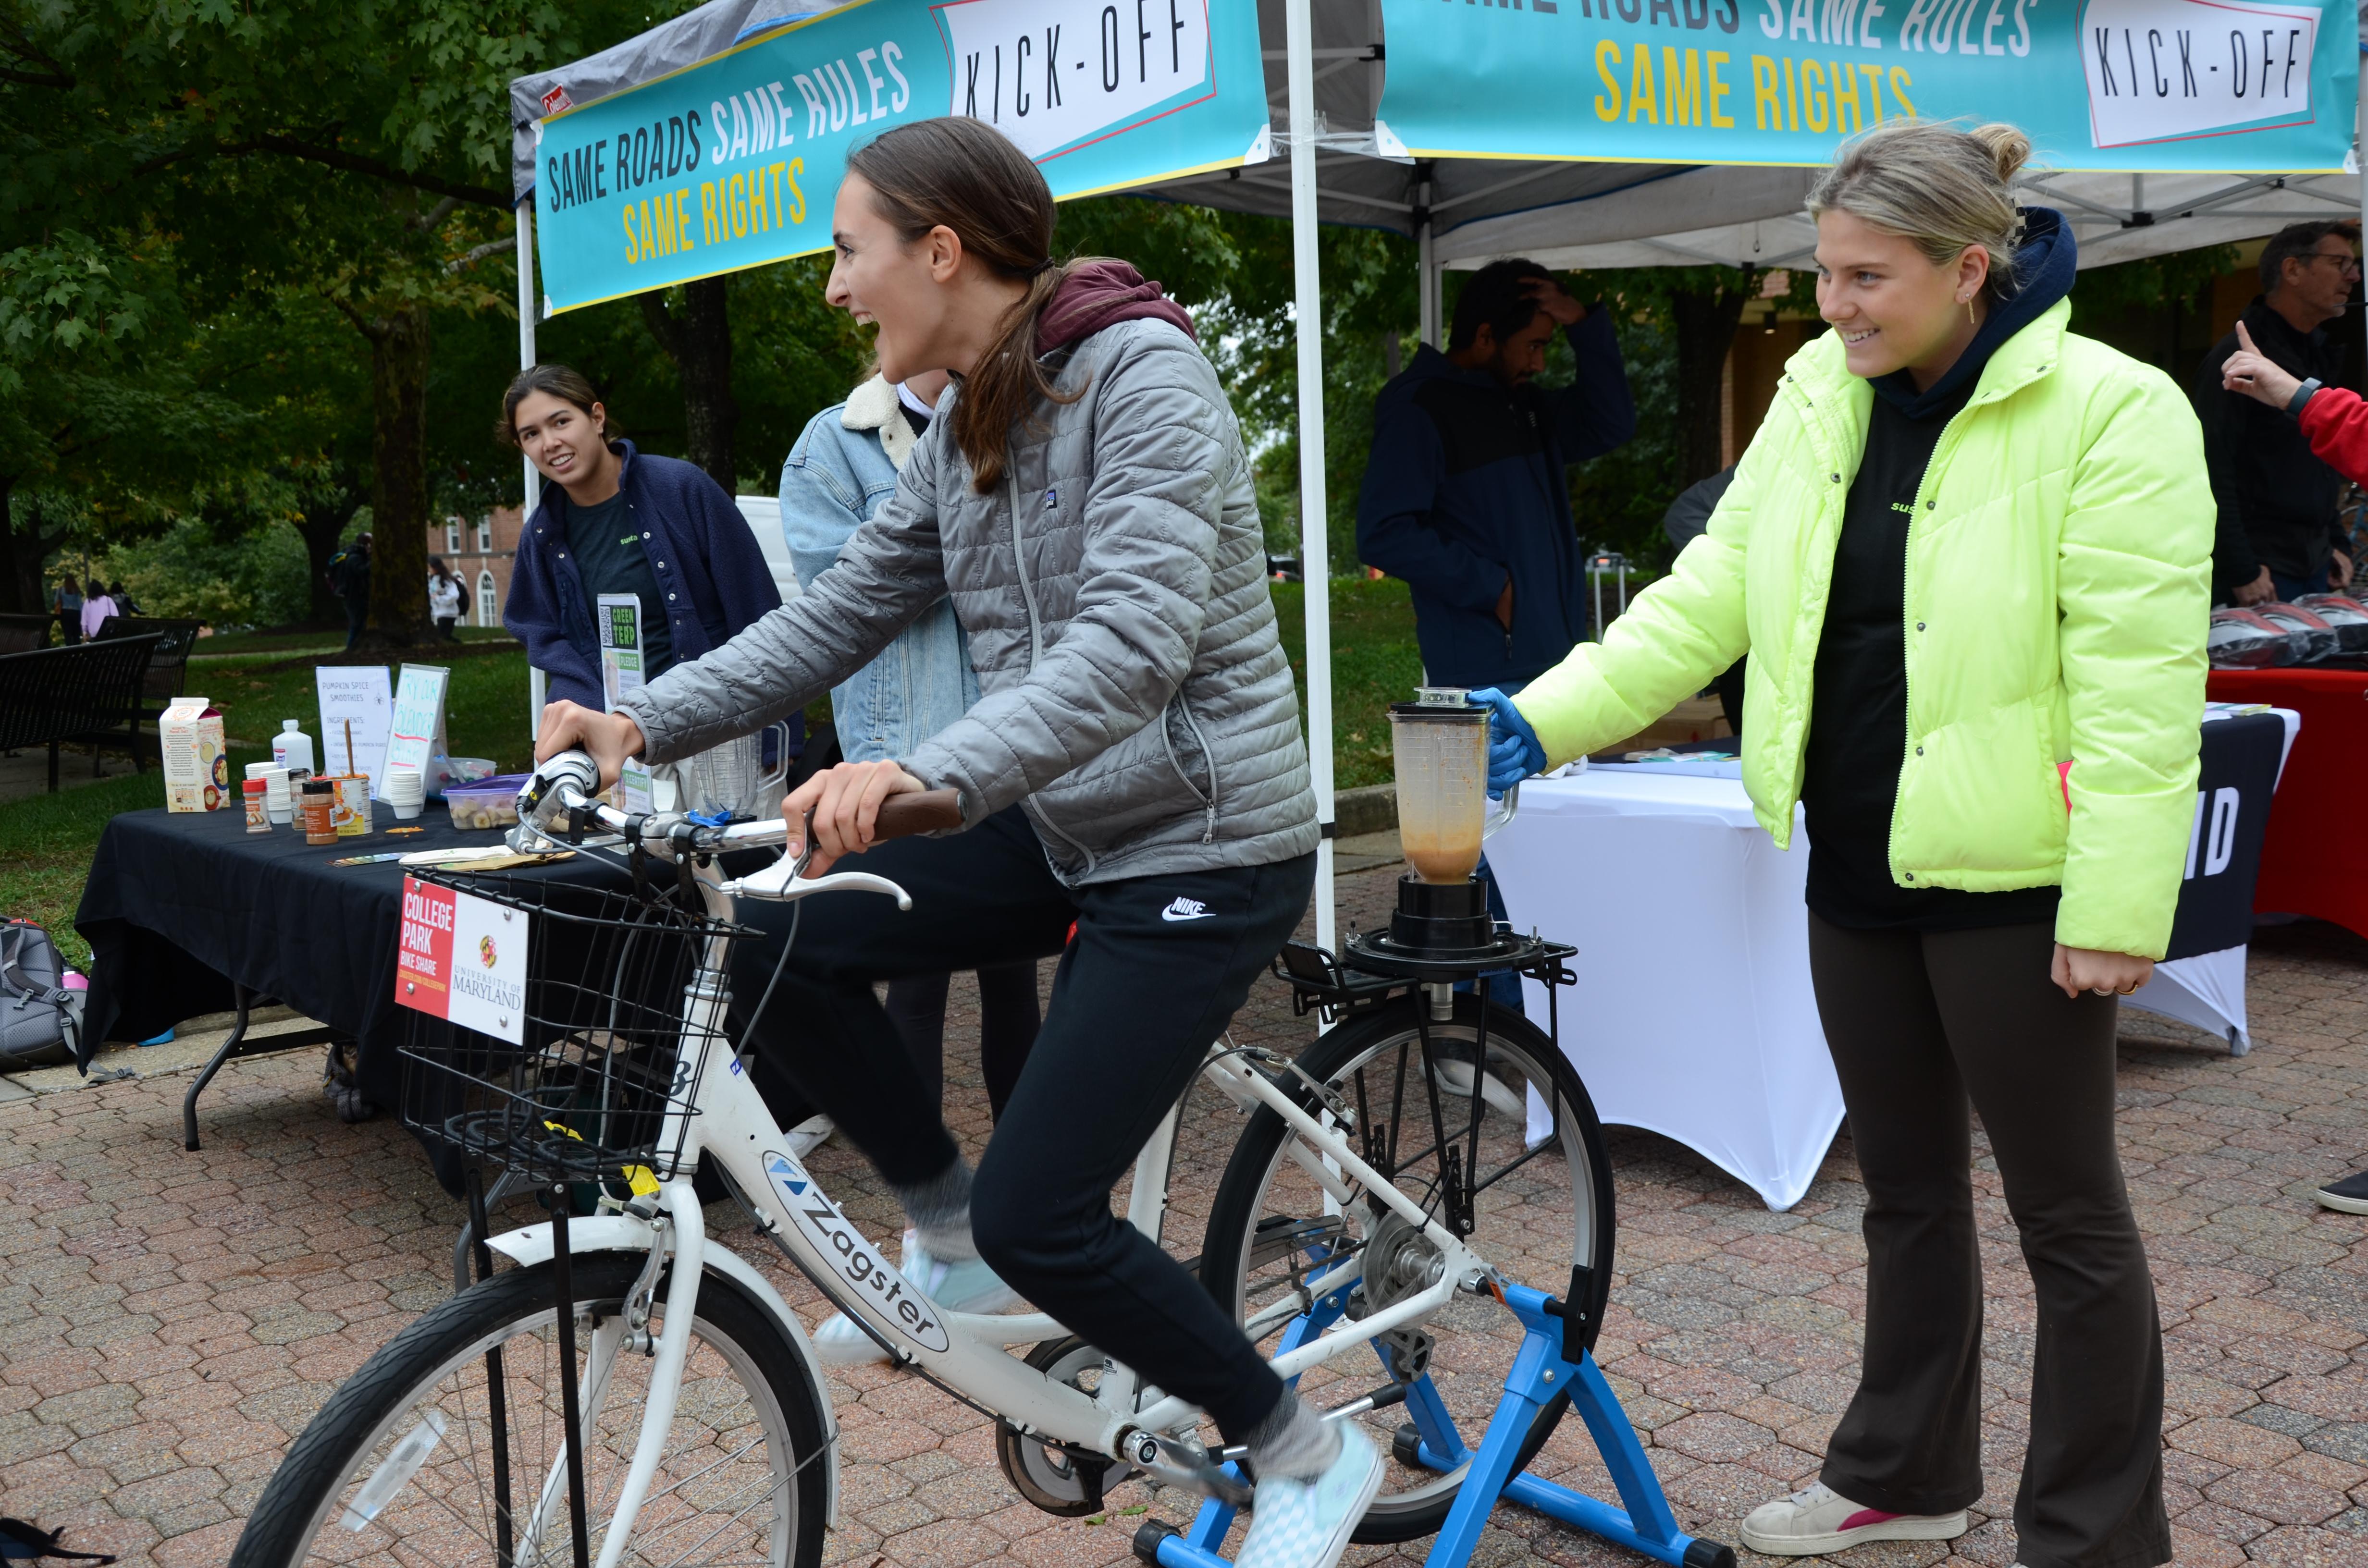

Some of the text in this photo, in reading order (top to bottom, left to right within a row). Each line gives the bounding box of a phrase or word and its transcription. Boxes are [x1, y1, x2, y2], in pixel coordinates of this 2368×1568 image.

[965, 0, 1184, 124] KICK-OFF
[2096, 27, 2300, 98] KICK-OFF
[1594, 39, 1917, 134] SAME RIGHTS
[548, 40, 910, 213] SAME ROADS SAME RULES
[623, 157, 806, 264] SAME RIGHTS
[612, 608, 634, 624] GREEN
[613, 625, 635, 645] TERP
[402, 674, 417, 700] TRY
[395, 704, 434, 739] BLENDER
[404, 892, 453, 931] COLLEGE
[1171, 896, 1206, 915] NIKE
[402, 920, 433, 956] PARK
[400, 950, 436, 976] BIKE SHARE
[454, 965, 521, 992] UNIVERSITY OF
[453, 974, 521, 1010] MARYLAND
[802, 1191, 934, 1334] Zagster
